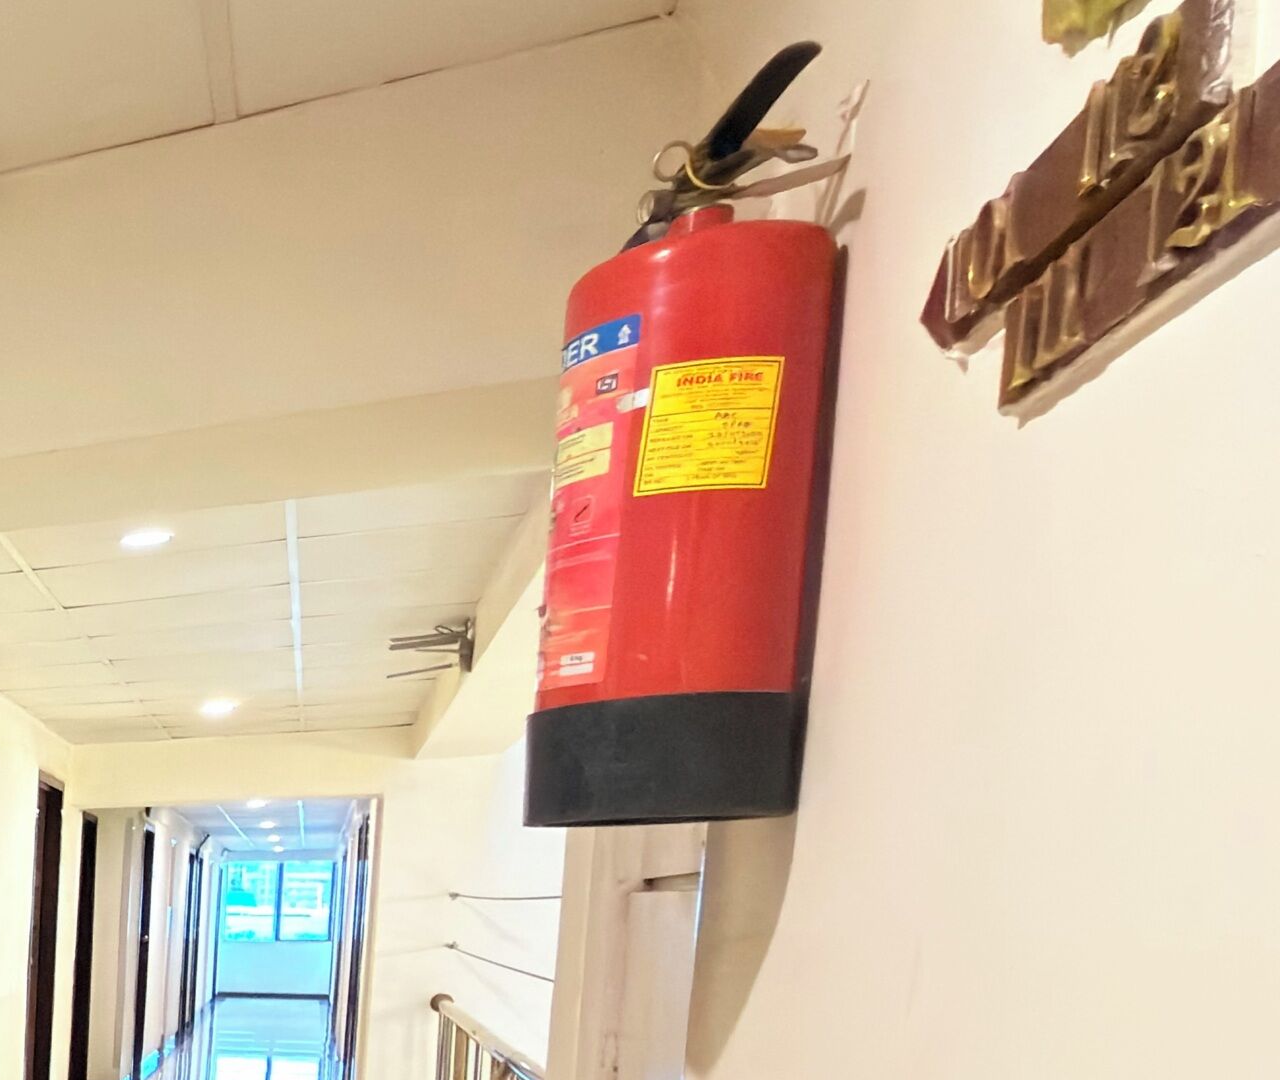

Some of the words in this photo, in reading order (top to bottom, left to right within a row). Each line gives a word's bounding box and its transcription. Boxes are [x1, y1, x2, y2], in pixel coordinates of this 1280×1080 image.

[1137, 95, 1260, 287] 121
[677, 373, 723, 388] INDIA
[729, 371, 764, 384] FIRE
